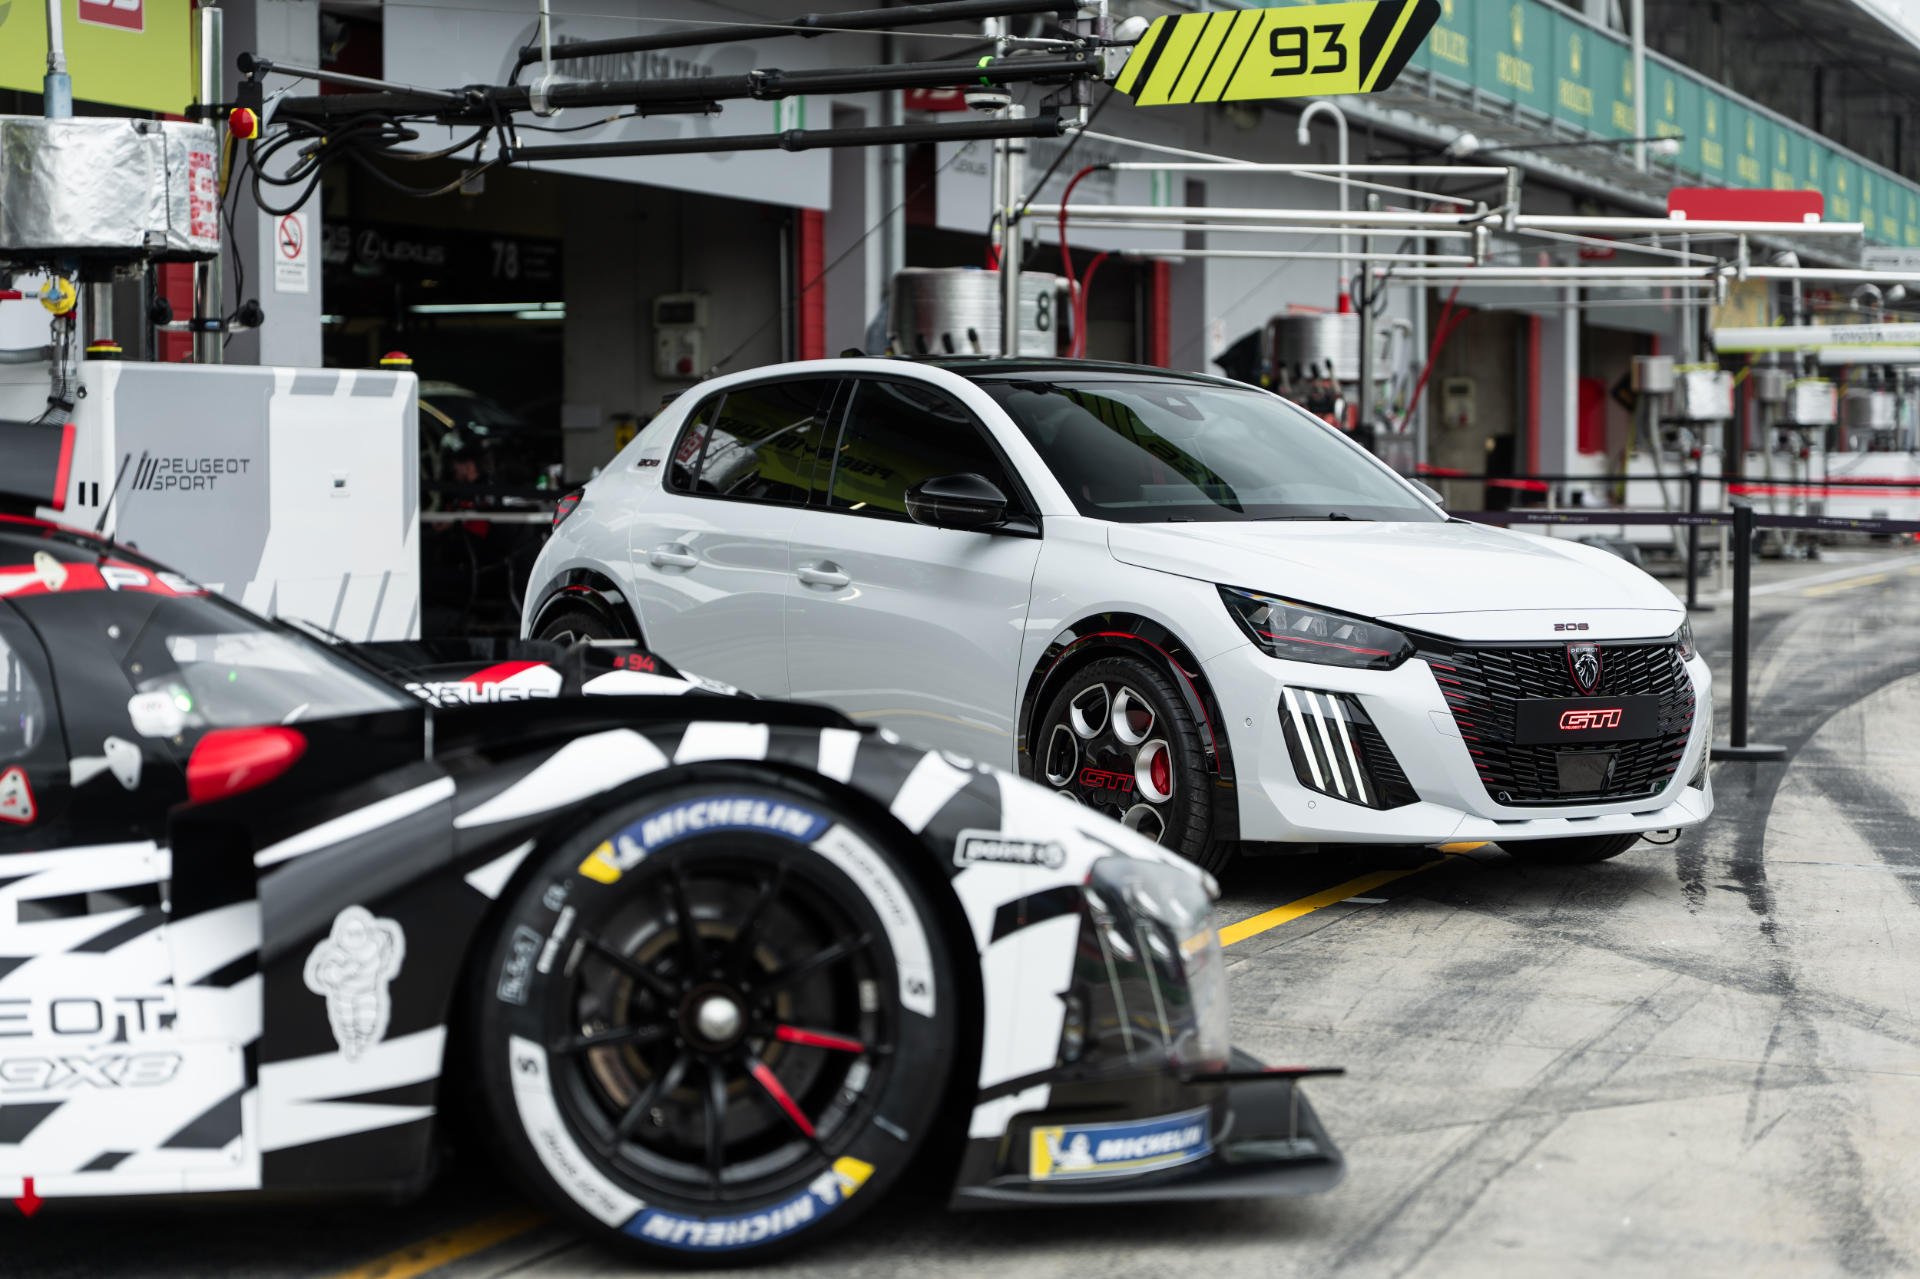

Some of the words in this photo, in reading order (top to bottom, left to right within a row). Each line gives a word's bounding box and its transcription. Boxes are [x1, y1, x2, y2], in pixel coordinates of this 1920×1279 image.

[1270, 23, 1347, 77] 93
[1036, 290, 1050, 332] 8
[159, 458, 250, 473] PEUGEOT
[153, 475, 217, 490] SPORT
[1554, 623, 1589, 631] 208
[1559, 708, 1622, 729] GTI
[1079, 767, 1135, 792] GTI
[642, 798, 814, 848] MICHELIN
[1096, 1126, 1203, 1161] MICHELIN
[643, 1202, 814, 1247] MICHELIN
